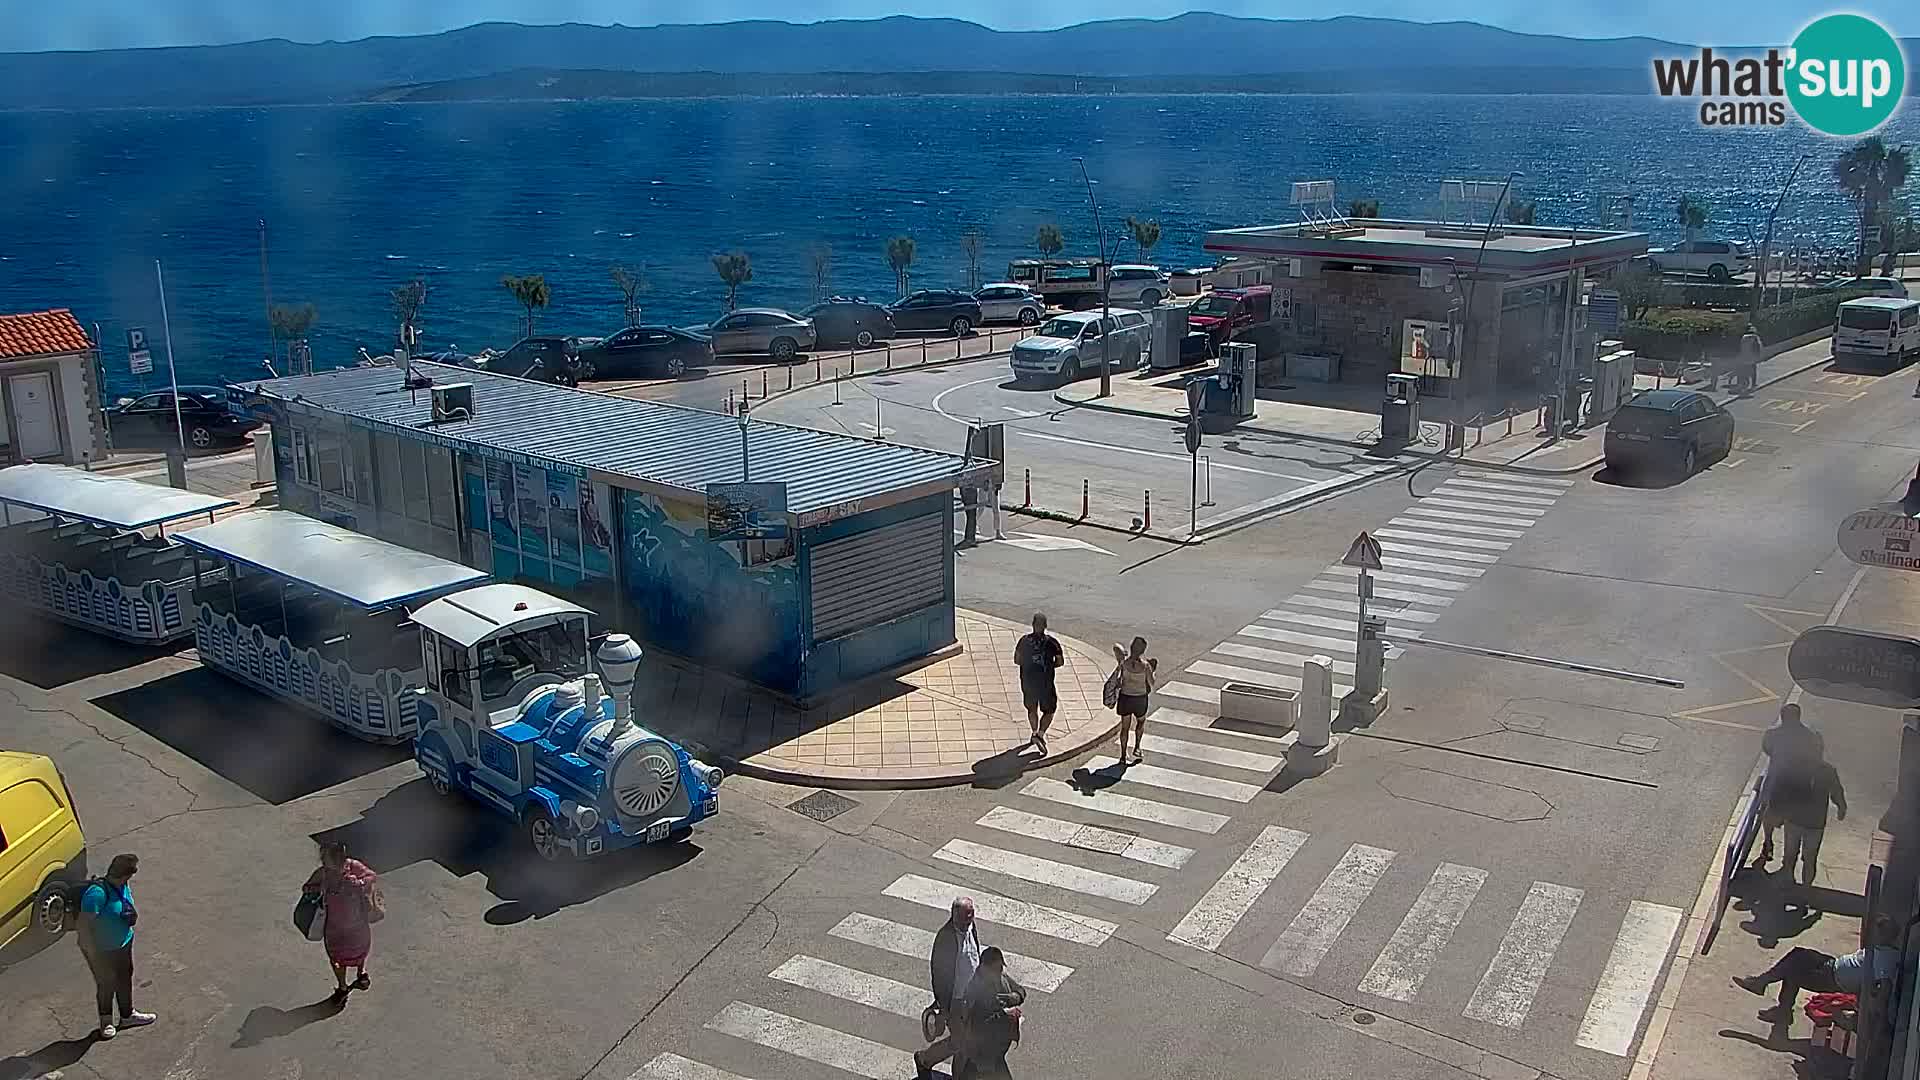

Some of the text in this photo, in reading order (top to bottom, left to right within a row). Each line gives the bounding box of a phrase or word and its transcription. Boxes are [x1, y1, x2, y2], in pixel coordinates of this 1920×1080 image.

[131, 330, 143, 348] P
[1760, 399, 1830, 414] TAXI
[495, 449, 527, 464] STATION
[529, 455, 555, 470] TICKET
[556, 462, 583, 476] OFFICE
[1848, 514, 1920, 533] PIZZE
